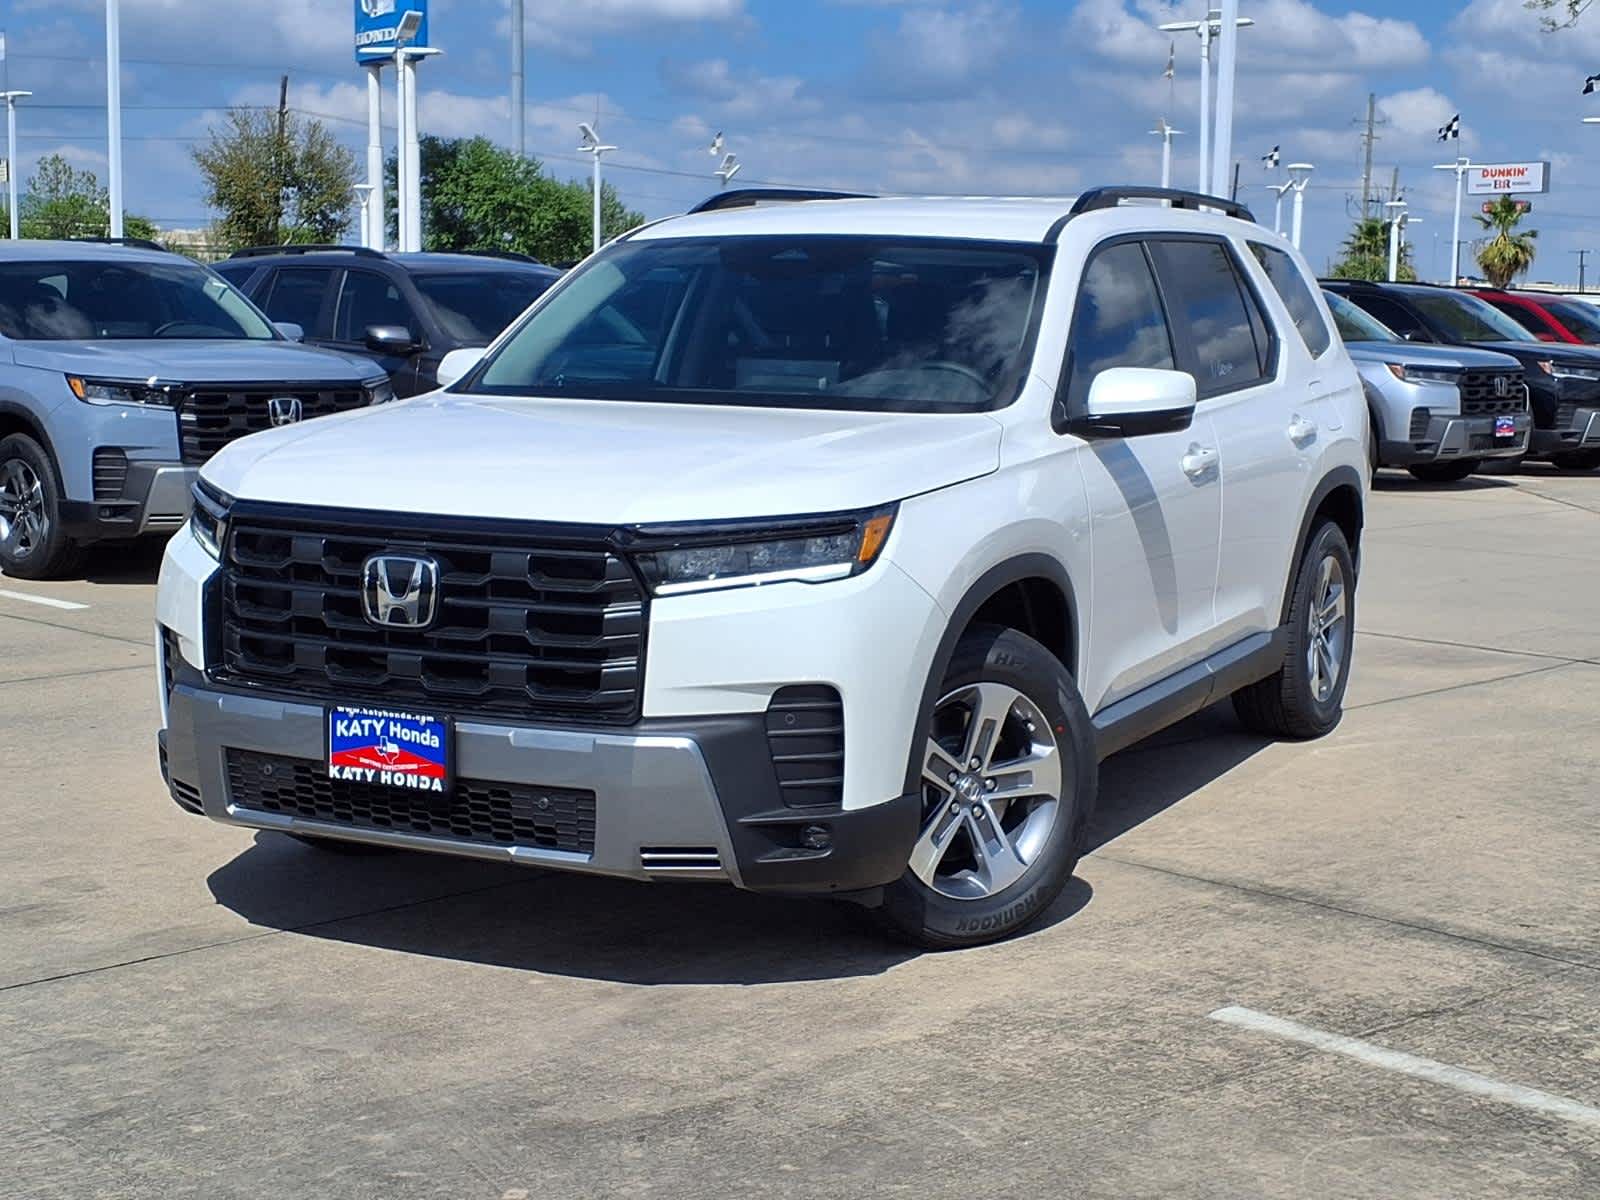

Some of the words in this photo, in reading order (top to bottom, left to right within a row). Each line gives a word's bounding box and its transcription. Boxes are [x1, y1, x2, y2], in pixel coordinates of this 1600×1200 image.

[356, 28, 396, 45] HOND
[1482, 168, 1528, 178] DUNKIN'
[336, 719, 386, 737] KATY
[389, 721, 440, 748] Honda
[328, 765, 376, 782] KATY
[380, 771, 443, 792] HONDA
